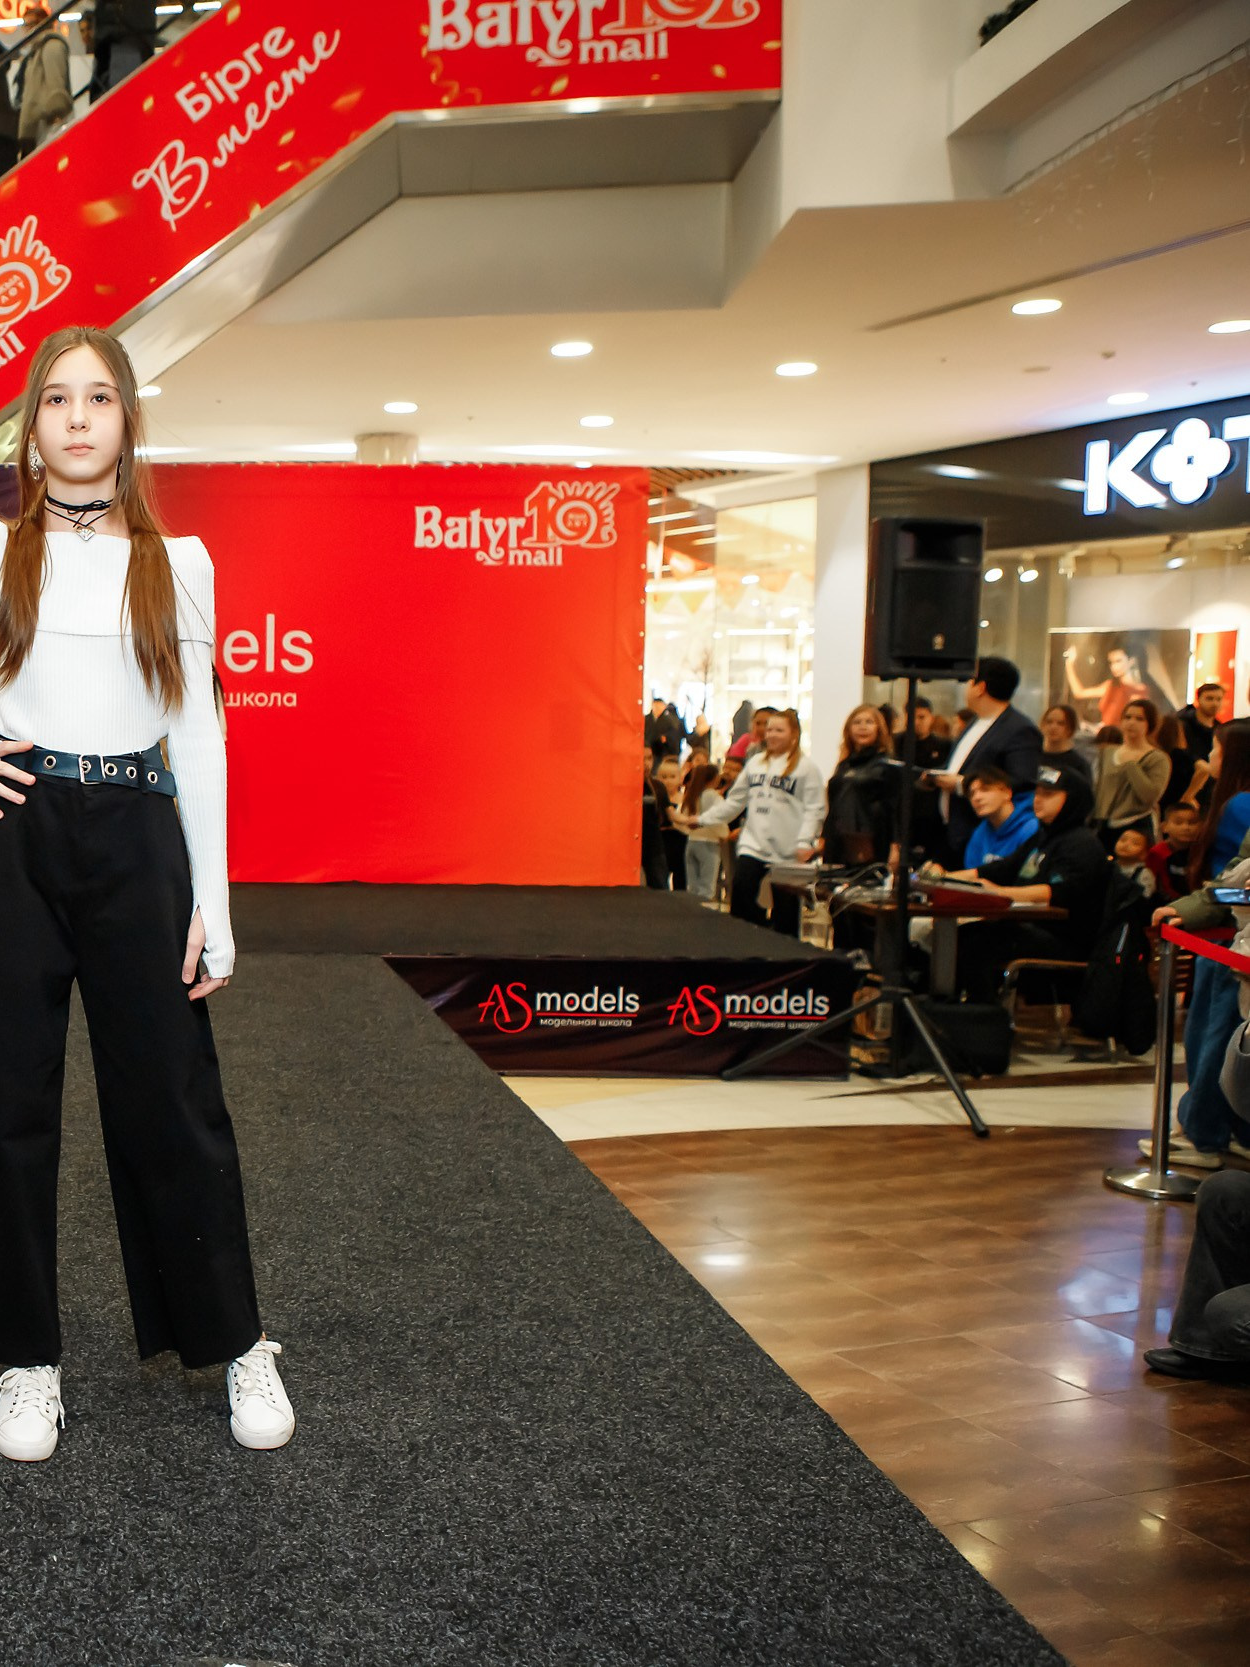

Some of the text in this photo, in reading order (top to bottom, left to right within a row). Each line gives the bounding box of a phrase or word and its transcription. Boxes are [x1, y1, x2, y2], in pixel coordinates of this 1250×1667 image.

[579, 30, 669, 64] mall
[175, 26, 294, 123] Бірге
[131, 29, 340, 232] Вместе
[413, 505, 527, 566] Batyr
[507, 545, 564, 567] mall
[213, 612, 315, 675] els
[536, 985, 640, 1013] models
[724, 987, 830, 1016] models
